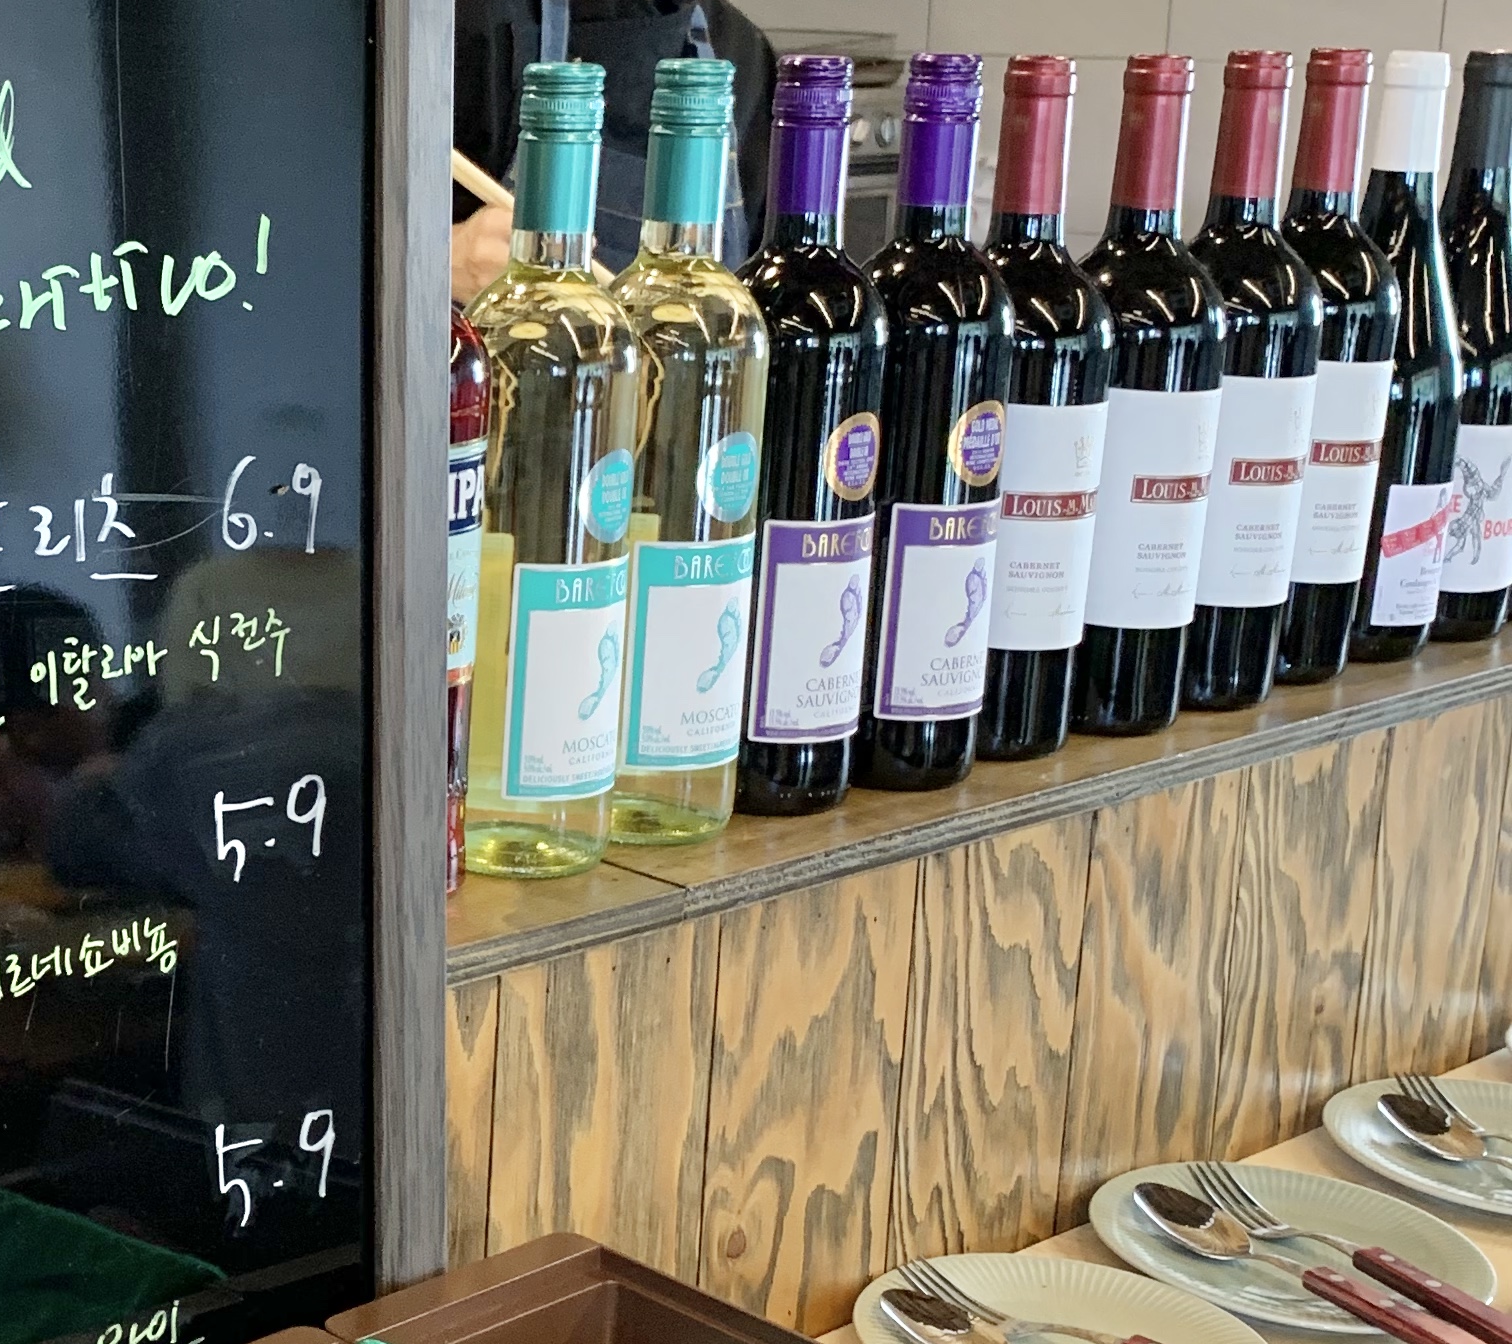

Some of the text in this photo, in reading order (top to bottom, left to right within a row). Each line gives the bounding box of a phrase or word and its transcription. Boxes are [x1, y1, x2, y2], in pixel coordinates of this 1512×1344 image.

[1320, 443, 1362, 463] LOUIS
[1239, 462, 1284, 482] LOUIS
[1142, 479, 1187, 500] LOUIS
[219, 456, 322, 555] 6.9
[1012, 495, 1063, 517] LOUIS
[1008, 571, 1064, 579] SAUVIGNON
[1009, 561, 1060, 570] CABERNET
[31, 636, 167, 712] 이탈리아
[189, 608, 292, 682] 식전주
[214, 774, 328, 882] 5.9
[215, 1109, 335, 1227] 5.9
